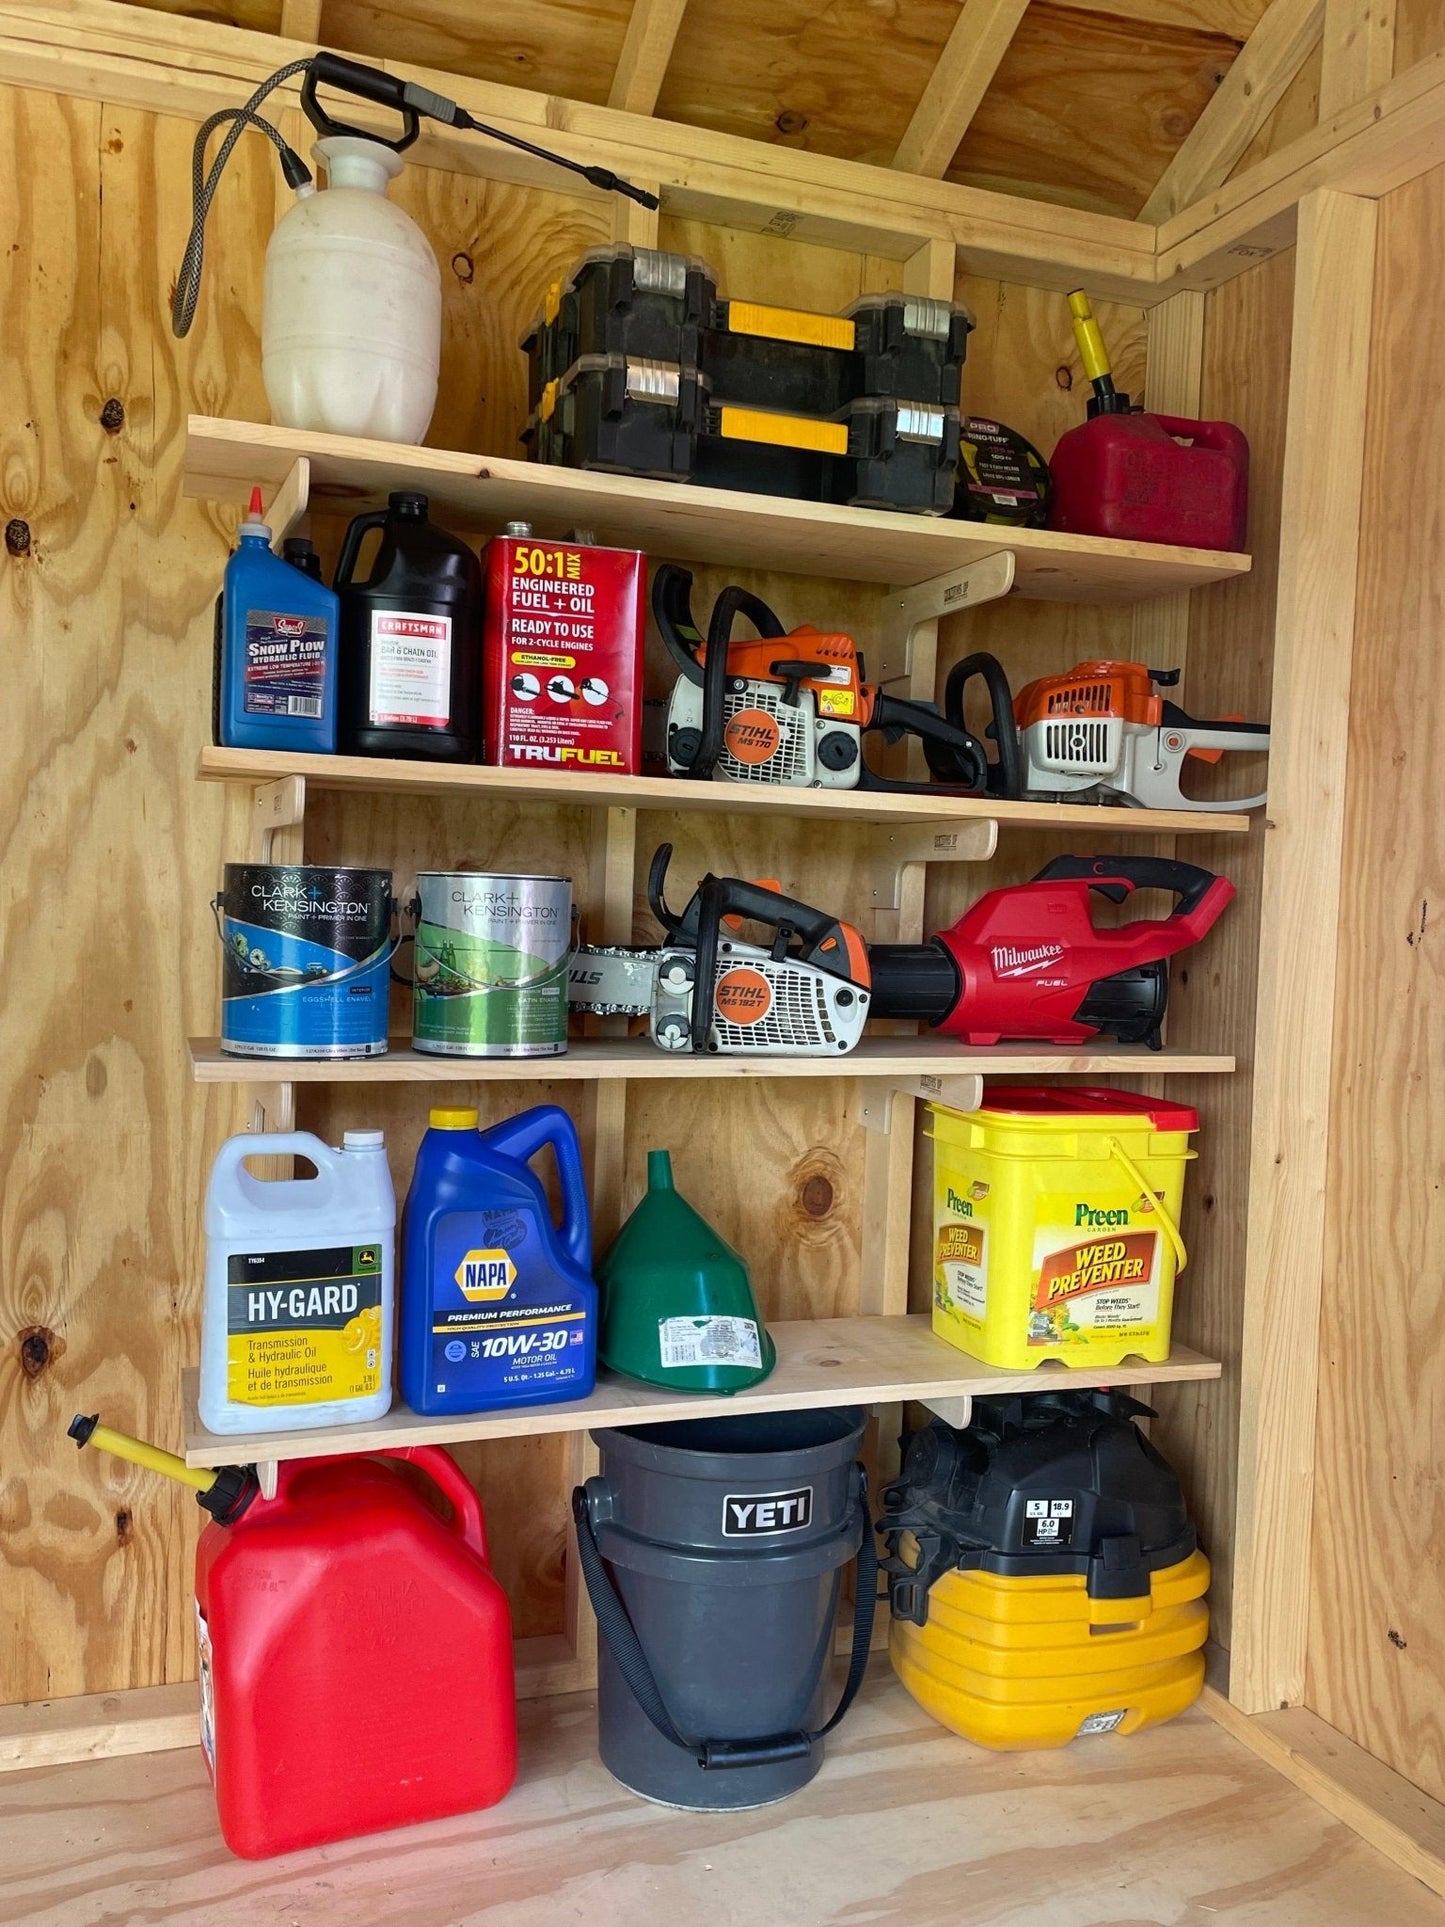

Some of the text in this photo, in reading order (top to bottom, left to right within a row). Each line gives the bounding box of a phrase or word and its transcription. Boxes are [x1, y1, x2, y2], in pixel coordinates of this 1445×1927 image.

[969, 422, 996, 432] PRO
[514, 547, 580, 579] 50:1 MIX
[512, 577, 595, 597] ENGINEERED
[512, 592, 595, 613] FUEL + OIL
[381, 621, 442, 634] CRAFTSMAN
[512, 619, 594, 639] READY TO USE
[249, 640, 325, 657] SNOW PLOW
[381, 645, 395, 655] BAR
[403, 648, 426, 658] CHAIN
[427, 650, 438, 659] OIL
[512, 637, 594, 651] FOR 2-CYCLE ENGINES
[253, 651, 321, 664] HYDRAULIC FLUID
[521, 654, 566, 663] ETHANOL-FREE
[510, 707, 535, 716] DANGER:
[729, 724, 774, 740] STIHL
[539, 736, 556, 744] (3.253
[557, 737, 575, 746] Liters)
[738, 738, 772, 749] MS 170
[509, 744, 625, 766] TRUFUEL
[263, 899, 369, 915] KENSINGTON
[463, 904, 559, 918] KENSINGTON
[991, 945, 1063, 970] Milwaukee
[569, 969, 604, 985] STI
[1035, 979, 1068, 987] FUEL
[720, 986, 765, 998] STIHL
[721, 998, 737, 1006] MS
[947, 1187, 973, 1218] Preen
[1075, 1203, 1129, 1226] Preen
[949, 1227, 969, 1244] WEED
[940, 1242, 978, 1260] PREVENTER
[1076, 1242, 1127, 1270] WEED
[466, 1262, 507, 1288] NAPA
[1048, 1258, 1145, 1300] PREVENTER
[248, 1284, 358, 1322] HY-GARD
[1095, 1304, 1113, 1312] Before
[448, 1303, 572, 1323] PREMIUM PERFORMANCE
[247, 1337, 308, 1351] Transmission
[471, 1330, 568, 1358] SAE 10W-30
[248, 1346, 317, 1364] & Hydraulic Oil
[512, 1355, 543, 1366] MOTOR
[544, 1353, 557, 1362] OIL
[248, 1363, 327, 1379] Huile hydraulique
[534, 1371, 545, 1379] 1.25
[247, 1374, 333, 1392] et de transmission
[730, 1497, 805, 1529] YETI
[1034, 1503, 1070, 1511] 5 18.9
[1041, 1520, 1055, 1528] 6.0
